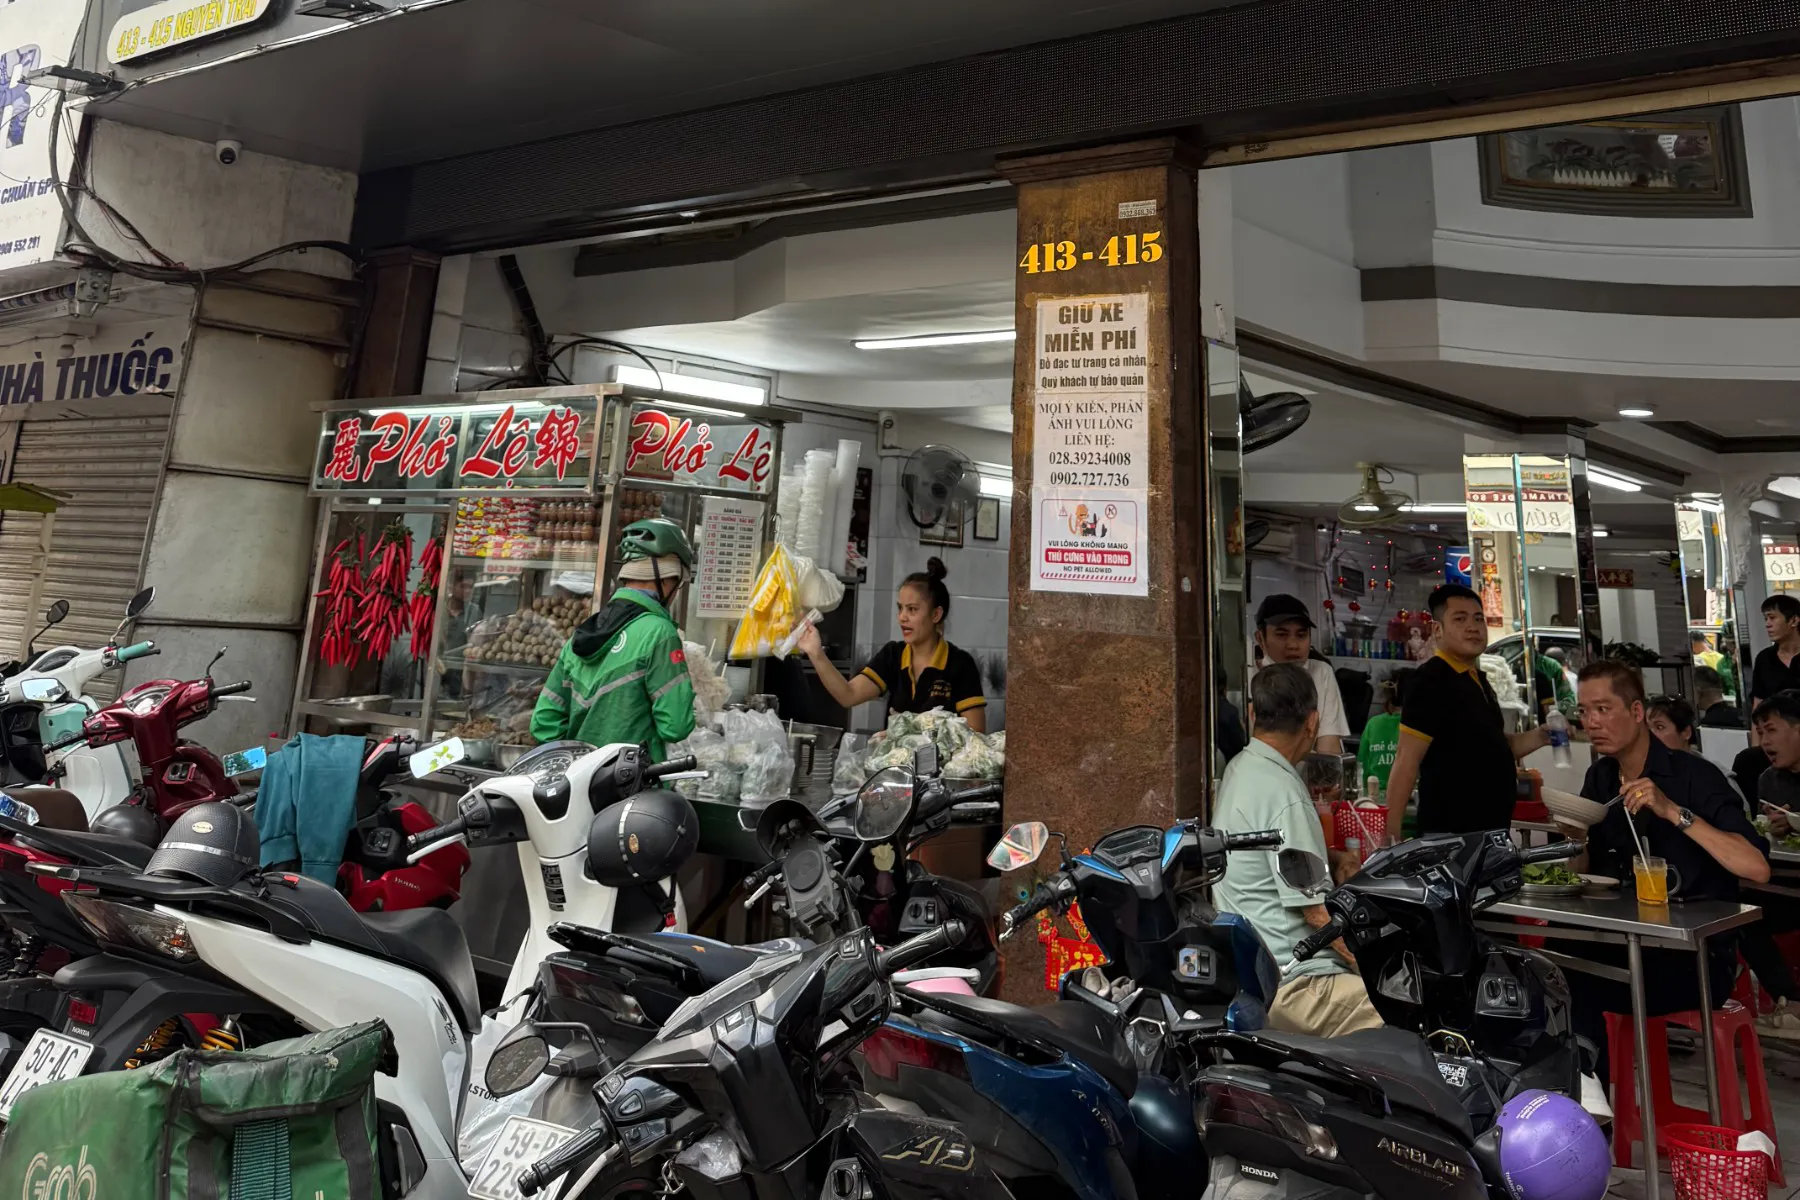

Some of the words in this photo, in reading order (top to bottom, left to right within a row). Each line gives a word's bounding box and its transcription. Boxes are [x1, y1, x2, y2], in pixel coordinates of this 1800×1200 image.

[116, 26, 141, 58] 413
[148, 14, 175, 49] 415
[1019, 240, 1077, 274] 413
[1099, 230, 1163, 268] 415
[1100, 302, 1124, 323] XE
[1044, 326, 1094, 353] MIỄN
[1101, 326, 1137, 350] PHÍ
[0, 351, 44, 405] HÀ
[55, 331, 173, 401] THUỐC
[1060, 375, 1087, 388] khách
[1039, 402, 1063, 415] MỌI
[1111, 398, 1143, 414] PHẢN
[1075, 418, 1096, 430] VUI
[1099, 415, 1133, 430] LÒNG
[324, 418, 360, 482] 麗
[362, 411, 456, 483] Phở
[460, 405, 530, 490] Lệ
[534, 406, 582, 482] 錦
[626, 409, 714, 474] Phở
[718, 426, 772, 491] Lệ
[1064, 432, 1092, 446] LIÊN
[1049, 451, 1131, 466] 028.39234008
[1050, 471, 1129, 487] 0902.727.736
[1103, 554, 1129, 565] TRONG
[22, 1144, 98, 1200] Grab
[1240, 1164, 1280, 1180] HONDA
